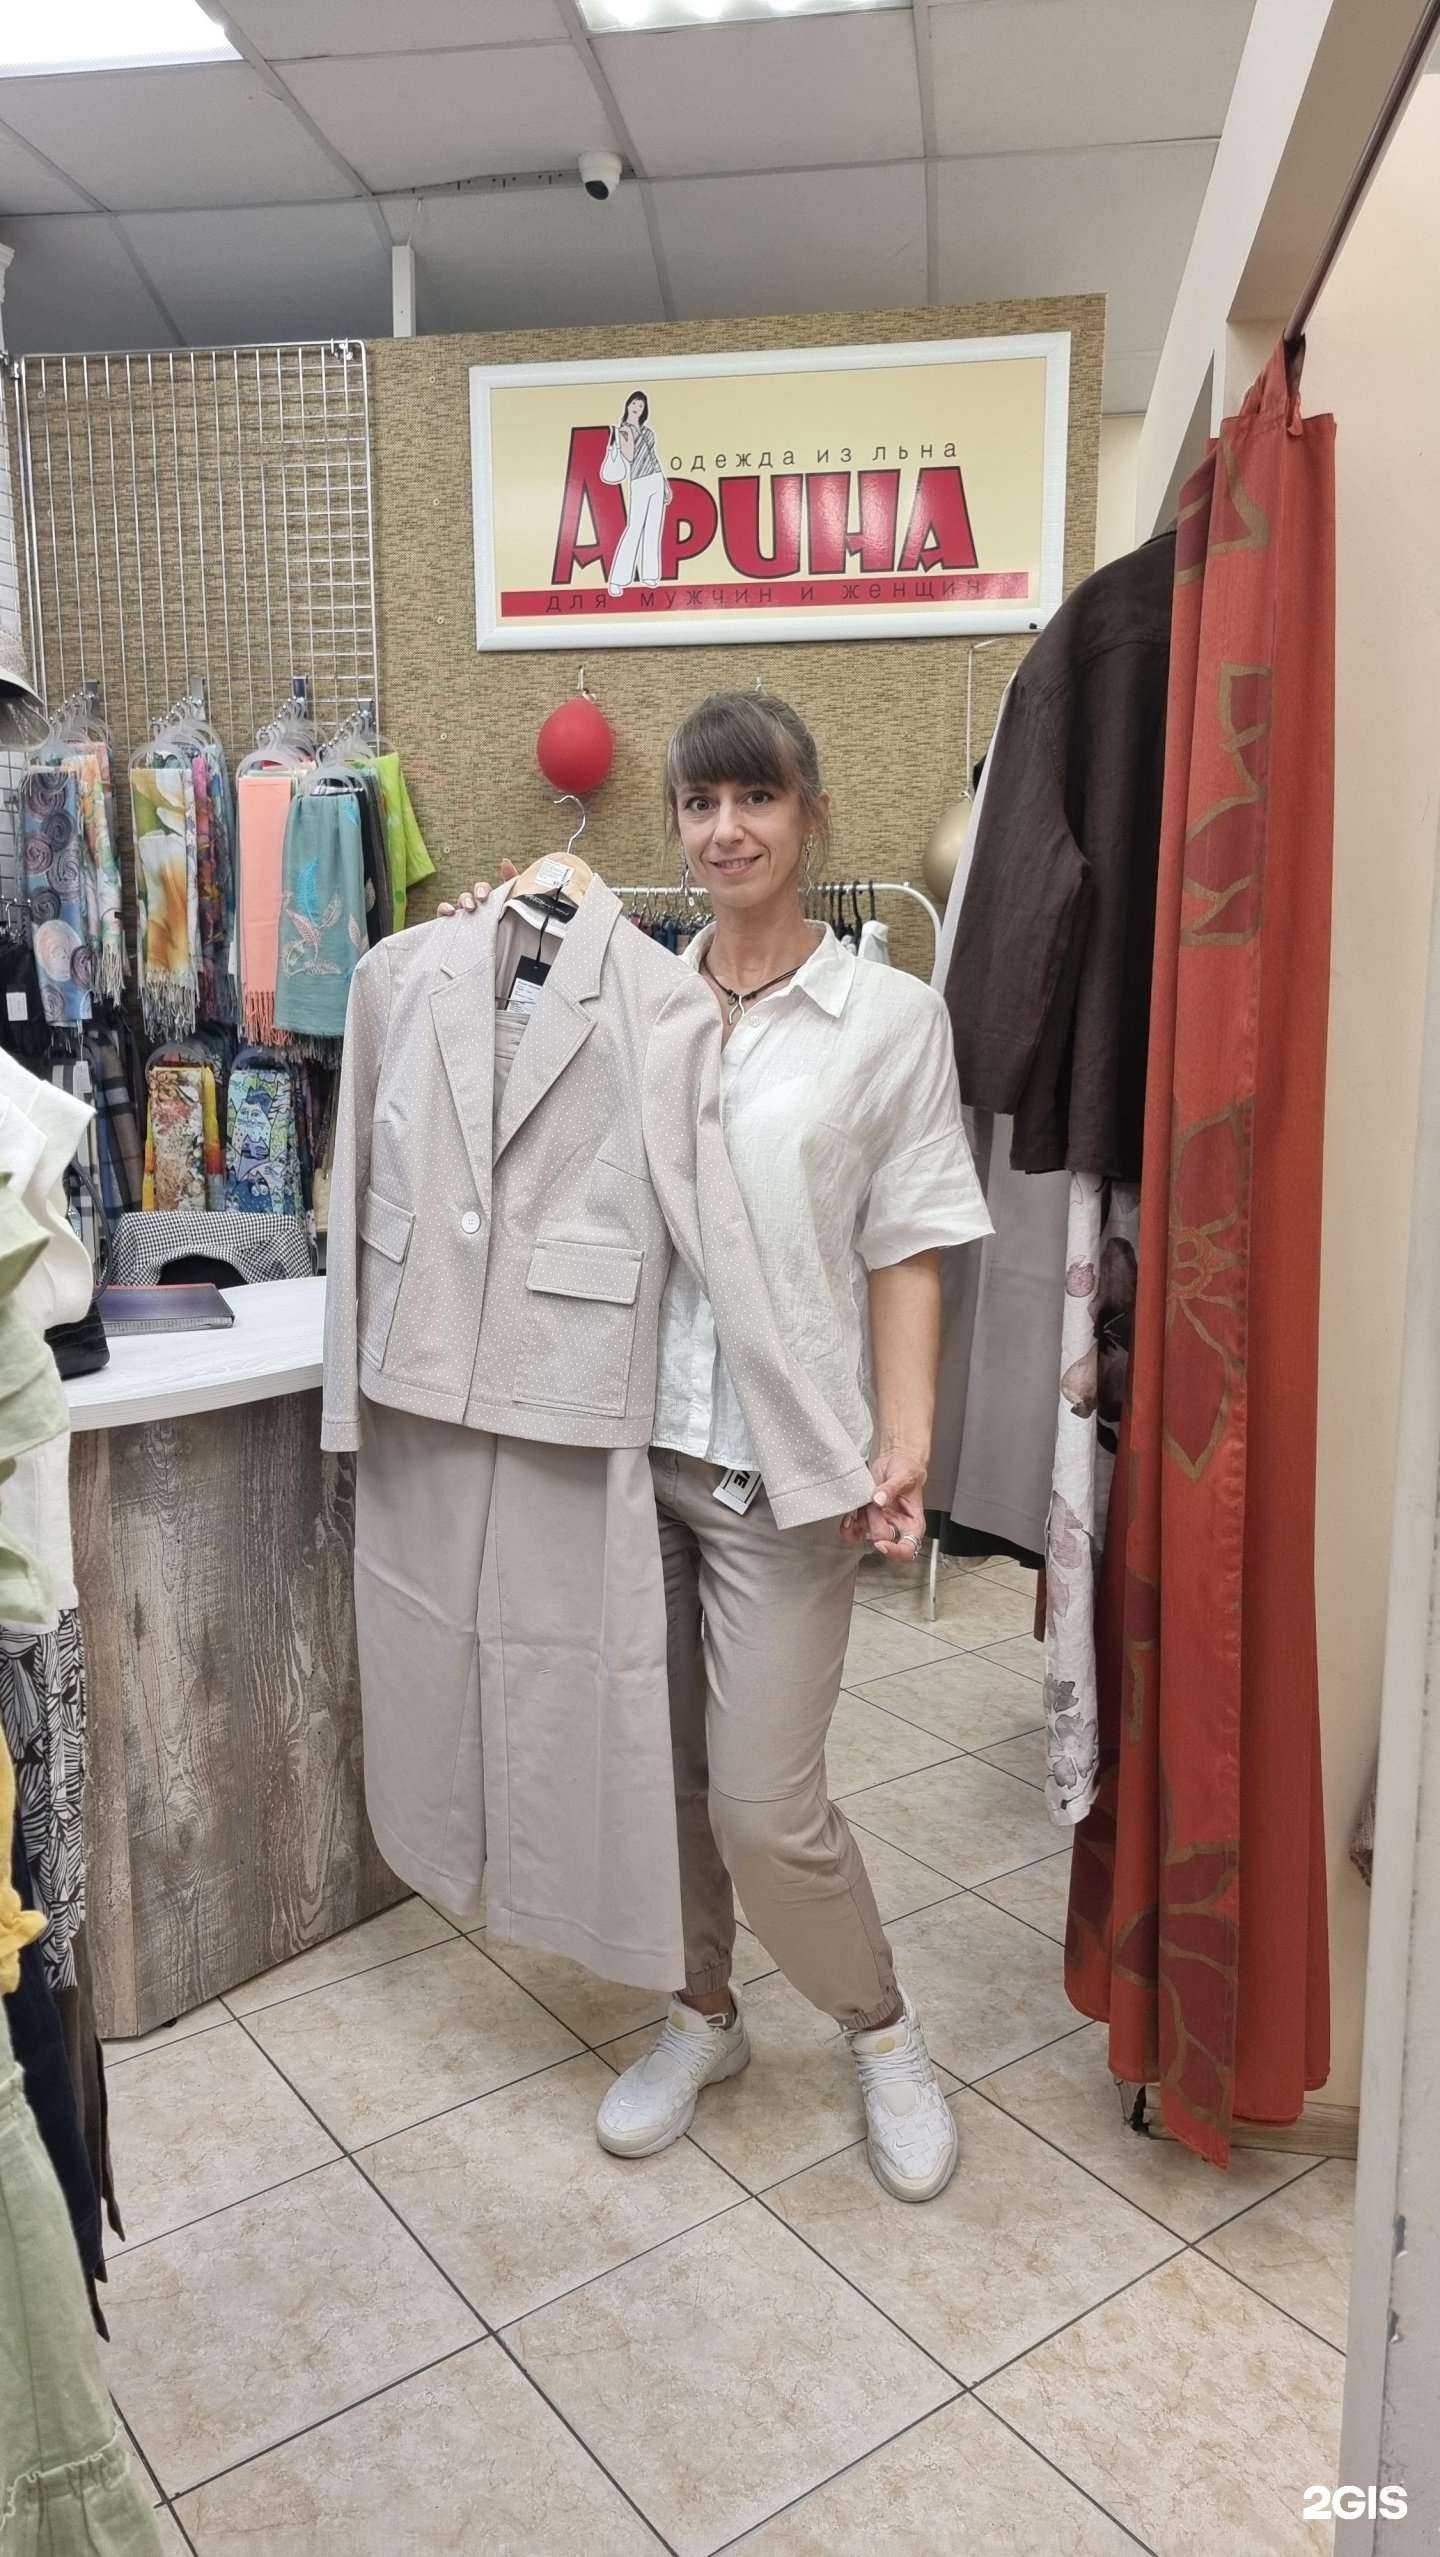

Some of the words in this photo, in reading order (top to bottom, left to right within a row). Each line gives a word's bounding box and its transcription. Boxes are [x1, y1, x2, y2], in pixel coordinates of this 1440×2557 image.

[670, 450, 795, 472] одежда
[817, 447, 852, 464] из
[872, 442, 957, 461] льна
[546, 594, 607, 613] для
[640, 587, 772, 609] мужчин
[801, 585, 814, 601] и
[842, 579, 980, 601] женщин
